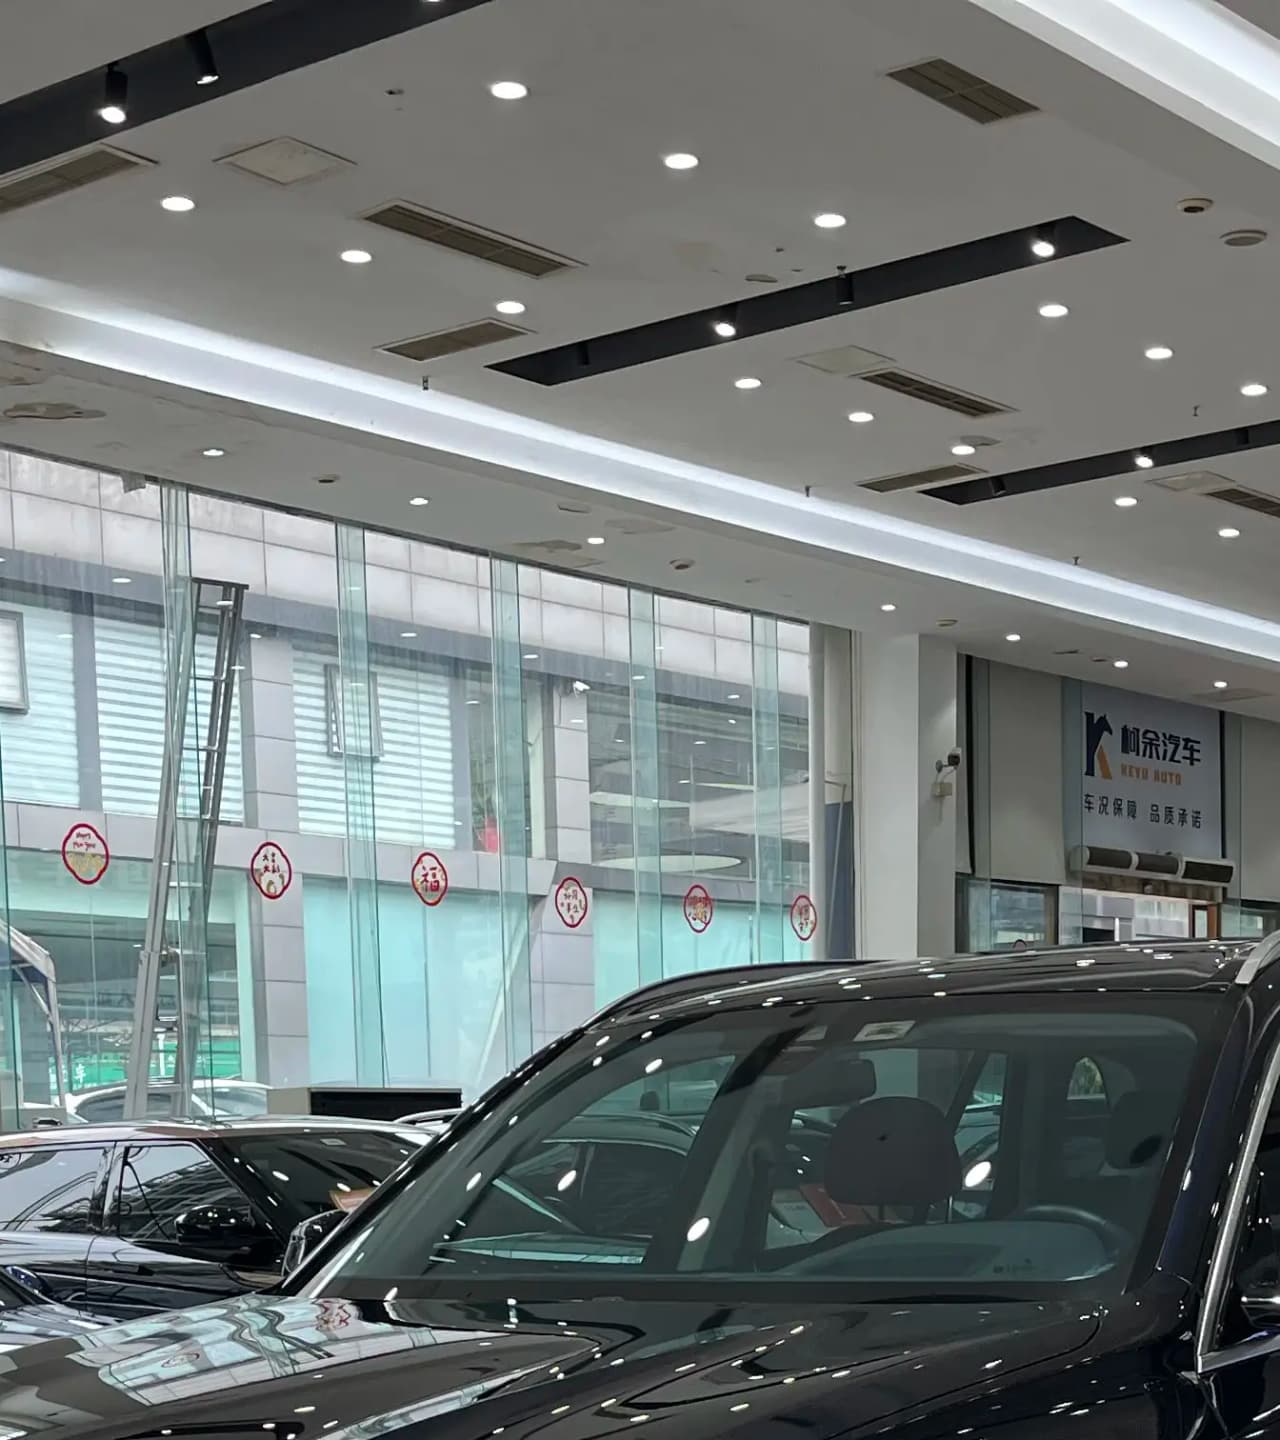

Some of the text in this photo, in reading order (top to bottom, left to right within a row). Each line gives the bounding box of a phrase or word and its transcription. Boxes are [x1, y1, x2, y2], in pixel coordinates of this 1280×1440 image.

[1120, 724, 1201, 766] 柯余汽车
[1150, 803, 1202, 829] 品质承诺
[420, 865, 440, 892] 福
